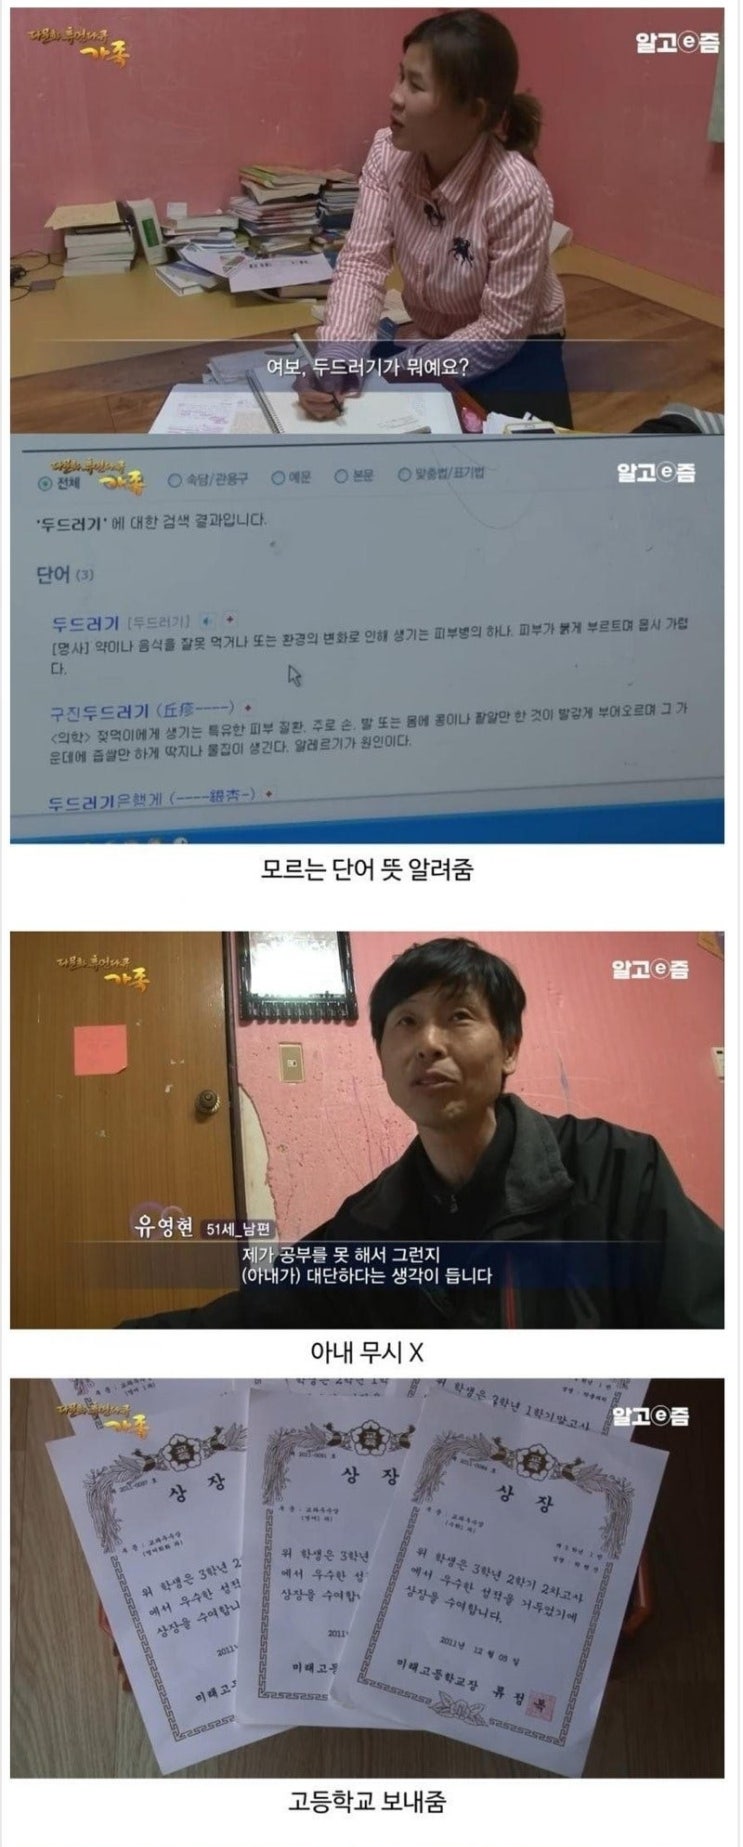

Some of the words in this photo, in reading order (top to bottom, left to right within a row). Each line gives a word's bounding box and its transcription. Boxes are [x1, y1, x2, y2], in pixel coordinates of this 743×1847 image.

[57, 475, 81, 490] 전체
[187, 471, 249, 487] 속담/관용구
[288, 470, 312, 485] 예문
[353, 468, 375, 483] 본문
[415, 466, 485, 481] 맞춤법/표기법
[112, 516, 125, 531] 에
[130, 515, 158, 531] 대한
[163, 513, 190, 530] 검색
[195, 511, 267, 529] 결과입니다.
[36, 564, 71, 585] 단어
[76, 567, 95, 583] (3)
[52, 615, 120, 633] 두드러기
[50, 702, 151, 723] 구진두드러기
[48, 750, 87, 766] 운데에
[134, 746, 160, 762] 하게
[164, 743, 203, 760] 딱지나
[249, 740, 289, 756] 생긴다.
[294, 737, 356, 754] 알레르기가
[361, 733, 412, 751] 원인이다.
[496, 1484, 515, 1503] 상
[535, 1494, 554, 1514] 장
[410, 1566, 433, 1584] 에서
[440, 1574, 475, 1593] 우수한
[435, 1551, 468, 1572] 학생은
[472, 1561, 502, 1582] 3학년
[506, 1573, 537, 1592] 2학기
[405, 1583, 440, 1605] 상장을
[444, 1596, 503, 1624] 수여합니다.
